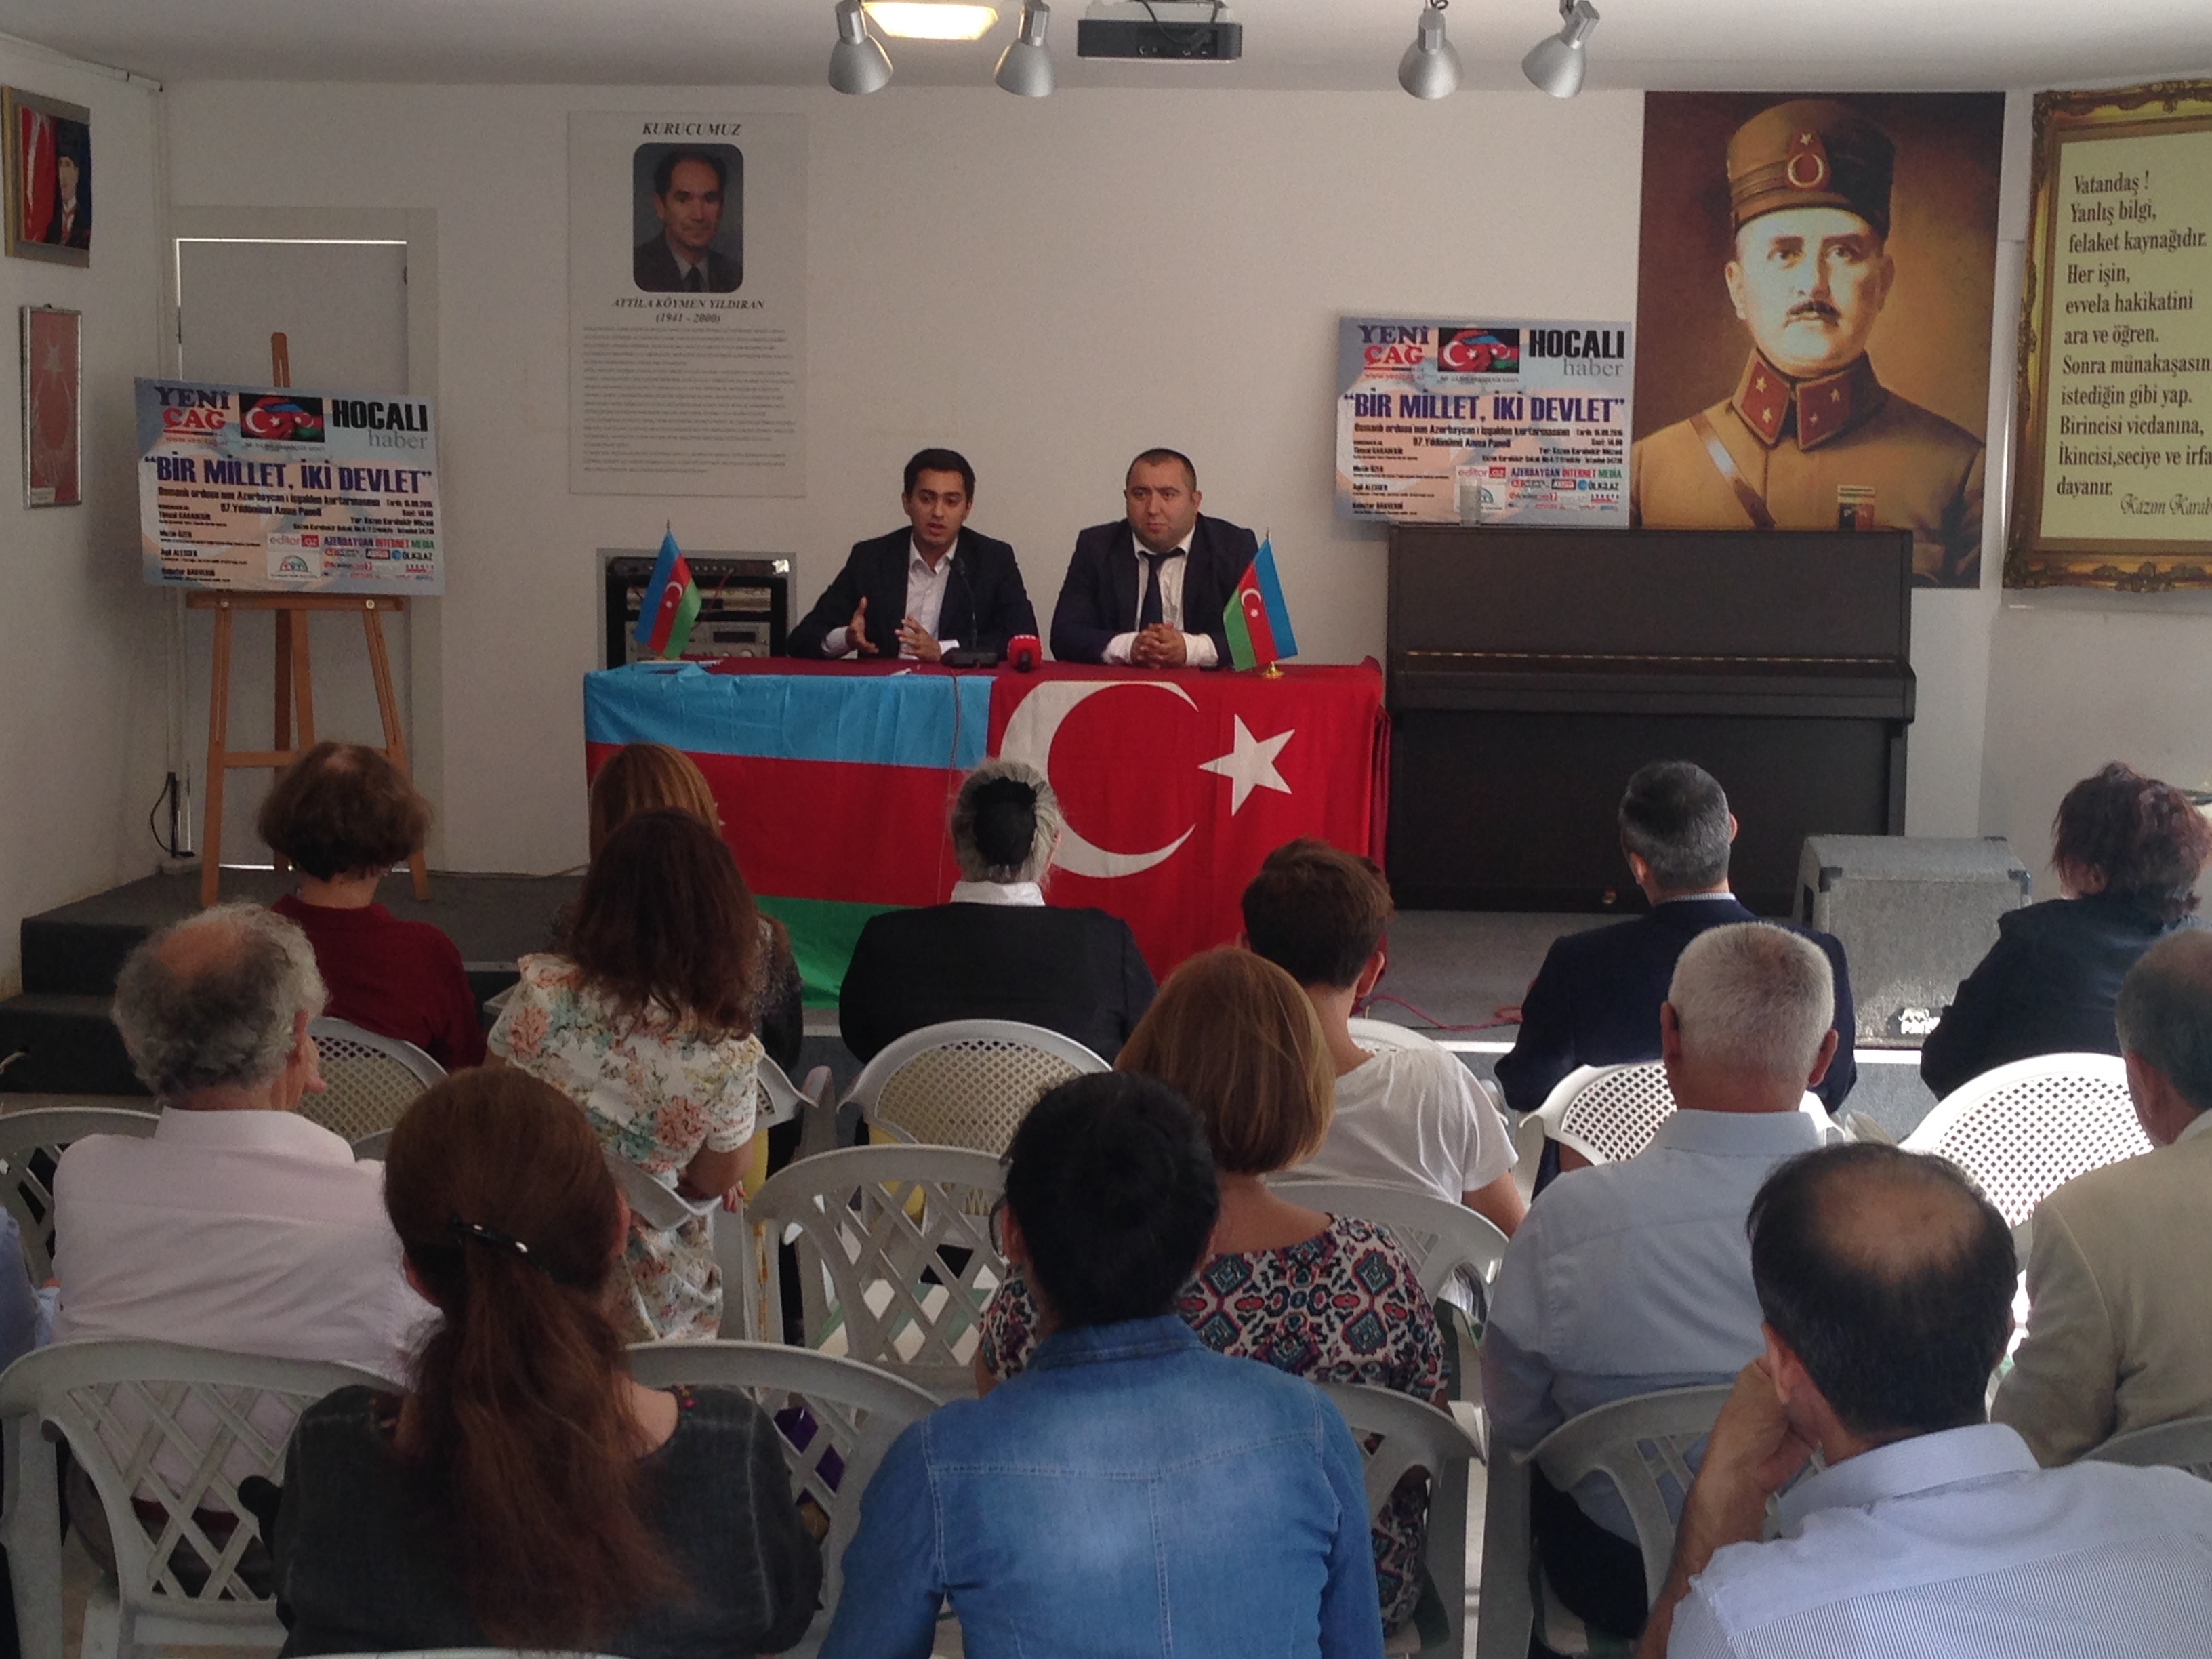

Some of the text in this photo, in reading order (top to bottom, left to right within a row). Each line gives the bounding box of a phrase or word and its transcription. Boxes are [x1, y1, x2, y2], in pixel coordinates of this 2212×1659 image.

[642, 122, 741, 136] KURUCUMUZ
[2074, 171, 2139, 196] Vatandaş
[2071, 198, 2156, 226] Yanlış bilgi,
[2069, 226, 2207, 255] felaket kaynağıdır.
[2068, 262, 2130, 287] Her işin,
[2066, 289, 2193, 314] evvela hakikatini
[1358, 325, 1430, 344] YENİ
[1529, 329, 1624, 359] HOCALI
[2064, 324, 2159, 347] ara ve öğren.
[1563, 358, 1623, 377] haber
[2062, 354, 2106, 375] Sonra
[154, 386, 230, 409] YENİ
[1493, 390, 1523, 421] İKİ
[2061, 384, 2193, 409] istediğin gibi yap.
[332, 399, 428, 432] HOCALI
[2060, 415, 2204, 436] Birincisi vicdanına,
[368, 429, 428, 449] haber
[2165, 451, 2181, 465] ve
[300, 458, 332, 490] İKİ
[2057, 475, 2113, 499] dayanır.
